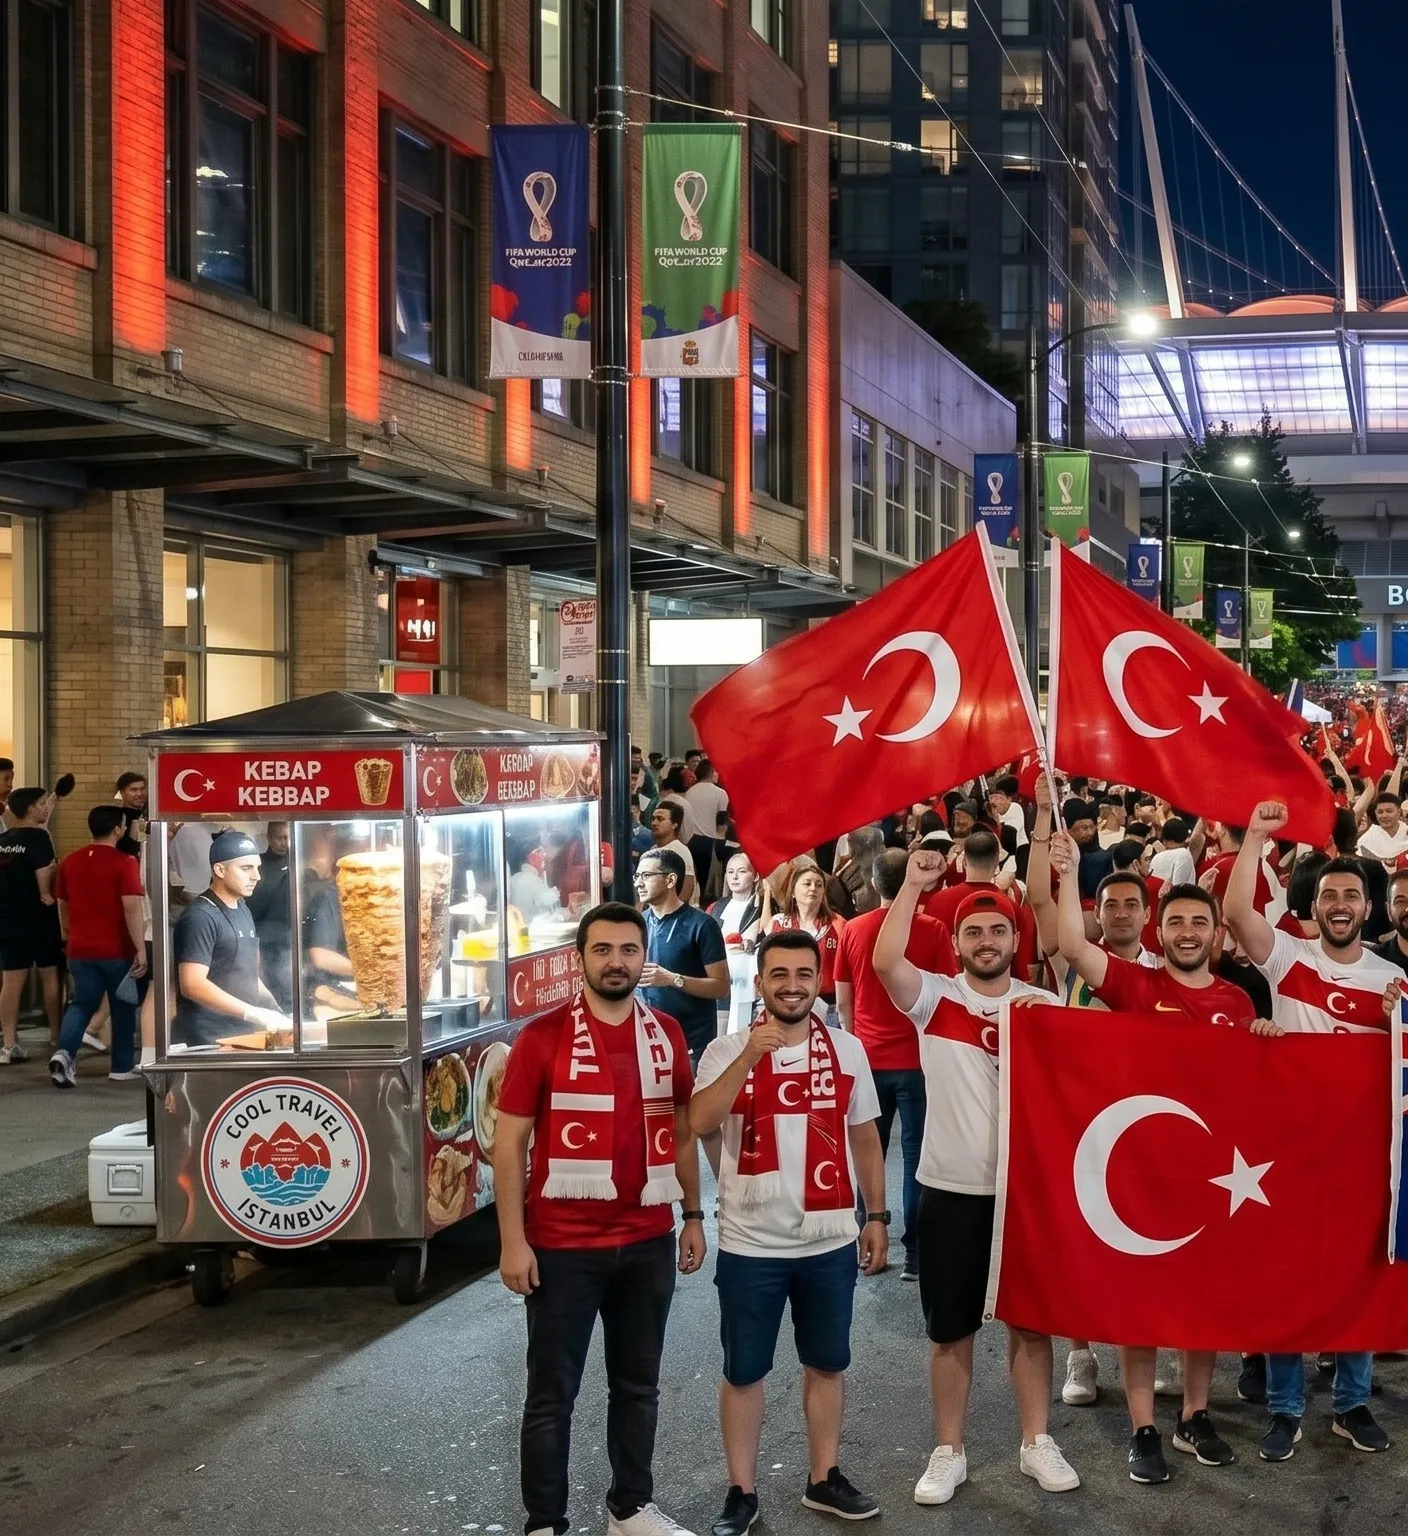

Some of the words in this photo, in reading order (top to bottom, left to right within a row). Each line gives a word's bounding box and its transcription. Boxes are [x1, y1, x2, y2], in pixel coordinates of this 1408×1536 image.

[709, 247, 728, 256] CUP
[244, 760, 322, 781] KEBAP
[238, 786, 330, 806] KEBBAP
[226, 1099, 271, 1140] COOL
[275, 1094, 344, 1142] TRAVEL
[237, 1197, 336, 1231] ISTANBUL
